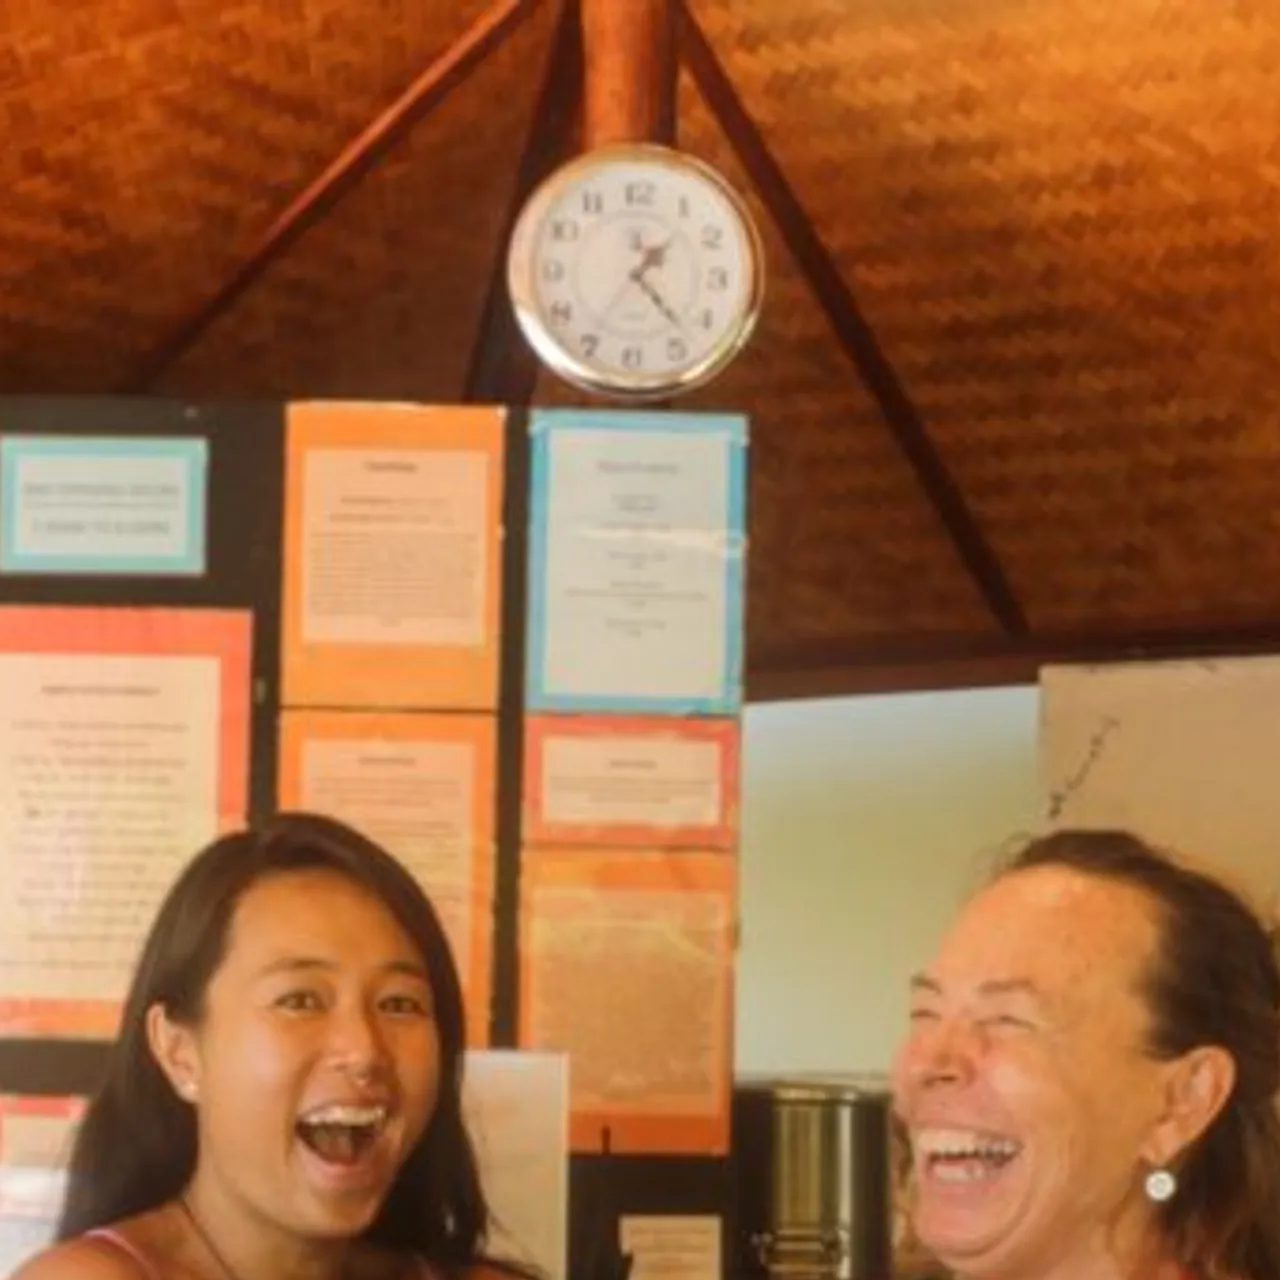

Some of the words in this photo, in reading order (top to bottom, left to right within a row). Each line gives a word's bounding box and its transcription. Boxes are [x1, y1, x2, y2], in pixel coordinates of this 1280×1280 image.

[582, 189, 604, 213] 11
[622, 181, 657, 207] 12
[677, 194, 690, 218] 1
[551, 219, 578, 241] 10
[701, 224, 724, 248] 2
[542, 261, 563, 282] 9
[707, 267, 728, 291] 3
[550, 300, 572, 322] 8
[694, 308, 713, 330] 4
[580, 334, 601, 358] 7
[621, 346, 642, 368] 6
[668, 338, 688, 362] 5
